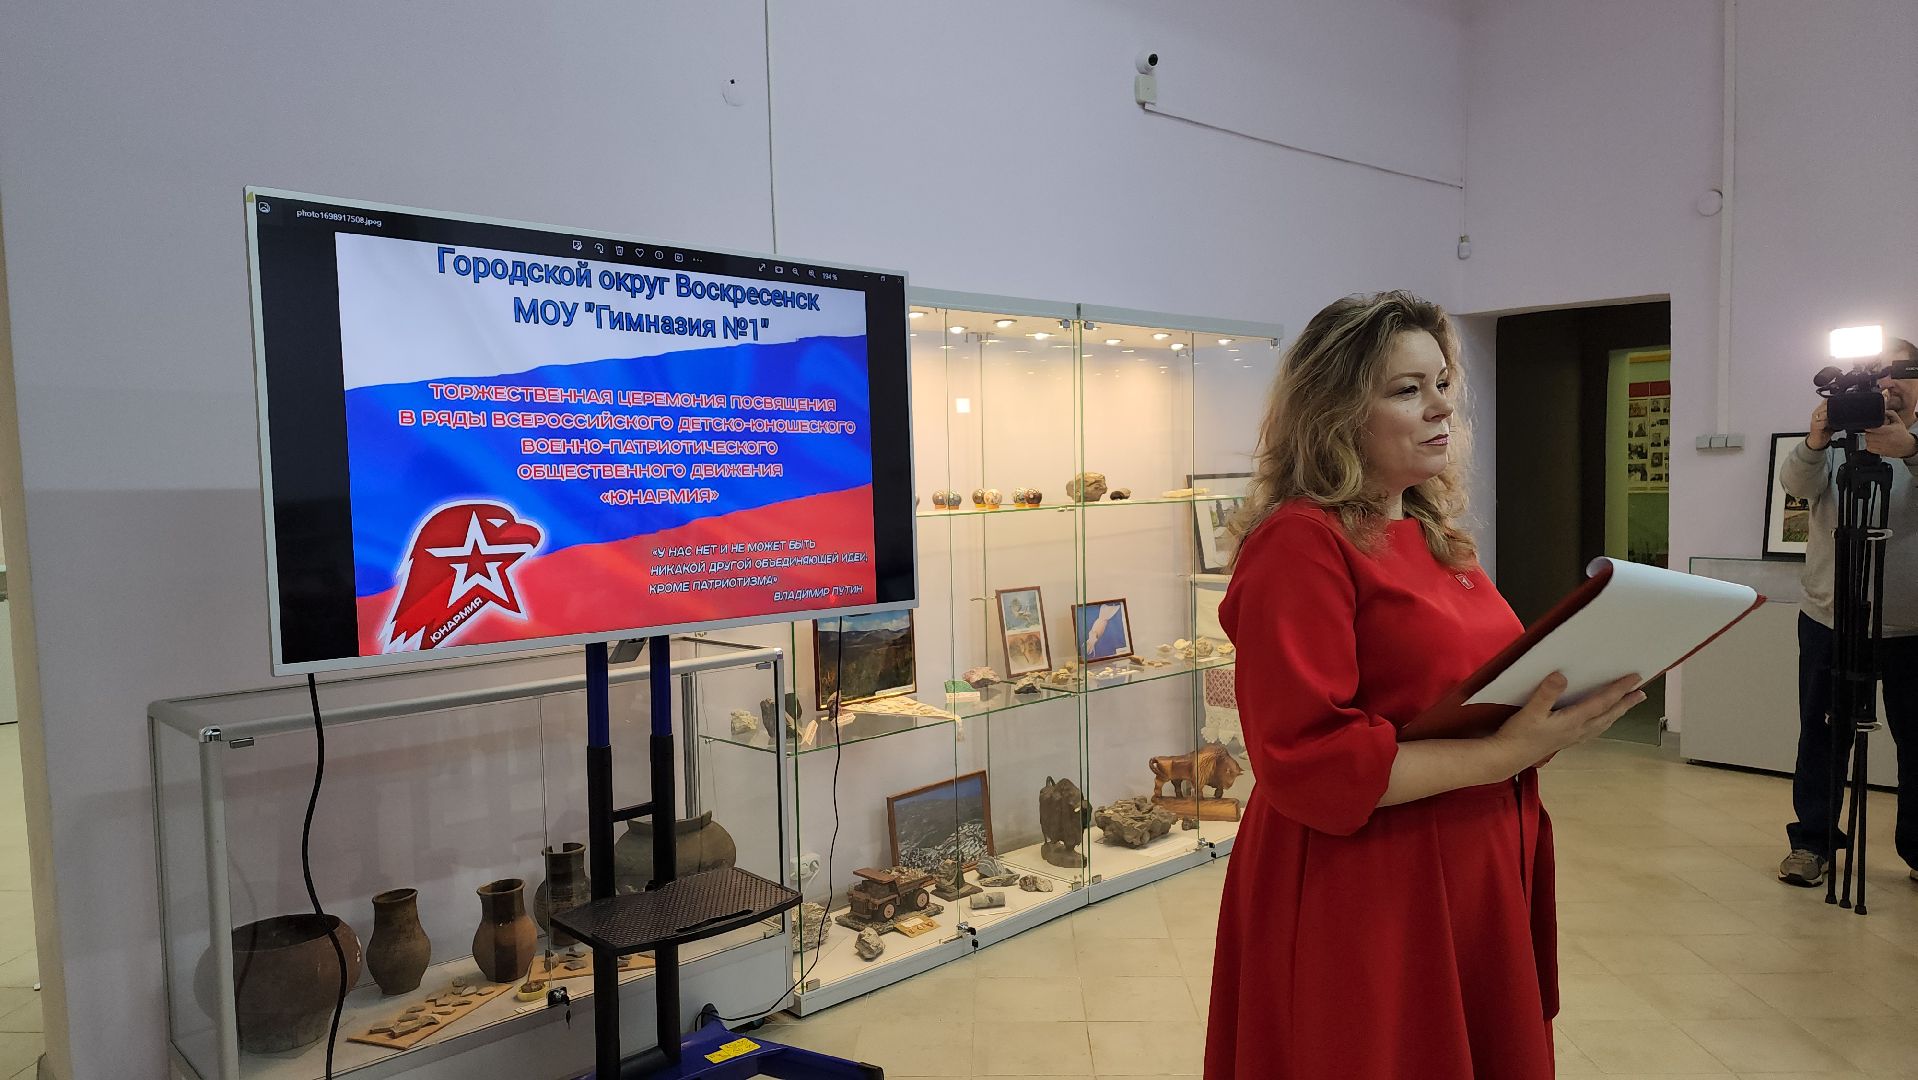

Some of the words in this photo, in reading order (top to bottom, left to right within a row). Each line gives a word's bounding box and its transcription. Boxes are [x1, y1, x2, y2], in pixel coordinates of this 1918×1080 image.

[437, 246, 592, 288] Городской
[598, 270, 670, 300] округ
[675, 273, 821, 311] Воскресенск
[513, 297, 578, 327] МОУ
[584, 302, 716, 338] "Гимназия
[722, 315, 770, 341] №1"
[428, 383, 614, 405] ТОРЖЕСТВЕННАЯ
[618, 390, 727, 409] ЦЕРЕМОНИЯ
[730, 395, 836, 412] ПОСВЯЩЕНИЯ
[398, 410, 415, 426] В
[421, 410, 487, 429] РЯДЫ
[491, 412, 673, 431] ВСЕРОССИЙСКОГО
[678, 416, 856, 435] ДЕТСКО-ЮНОШЕСКОГО
[521, 438, 778, 455] ВОЕННО-ПАТРИОТИЧЕСКОГО
[517, 463, 686, 481] ОБЩЕСТВЕННОГО
[690, 463, 783, 480] ДВИЖЕНИЯ
[600, 488, 719, 505] «ЮНАРМИЯ»
[652, 547, 666, 559] «У
[668, 546, 692, 557] НАС
[695, 544, 718, 555] НЕТ
[720, 543, 729, 554] И
[731, 542, 745, 553] НЕ
[747, 540, 787, 553] МОЖЕТ
[788, 539, 816, 549] БЫТЬ
[651, 560, 706, 576] НИКАКОЙ
[708, 557, 752, 573] ДРУГОЙ
[754, 553, 840, 570] ОБЪЕДИНЯЮЩЕЙ
[649, 581, 690, 595] КРОМЕ
[692, 576, 778, 591] ПАТРИОТИЗМА»
[773, 587, 830, 602] ВЛАДИМИР
[831, 585, 864, 597] ПУТИН
[430, 596, 484, 643] ЮНАРМИЯ
